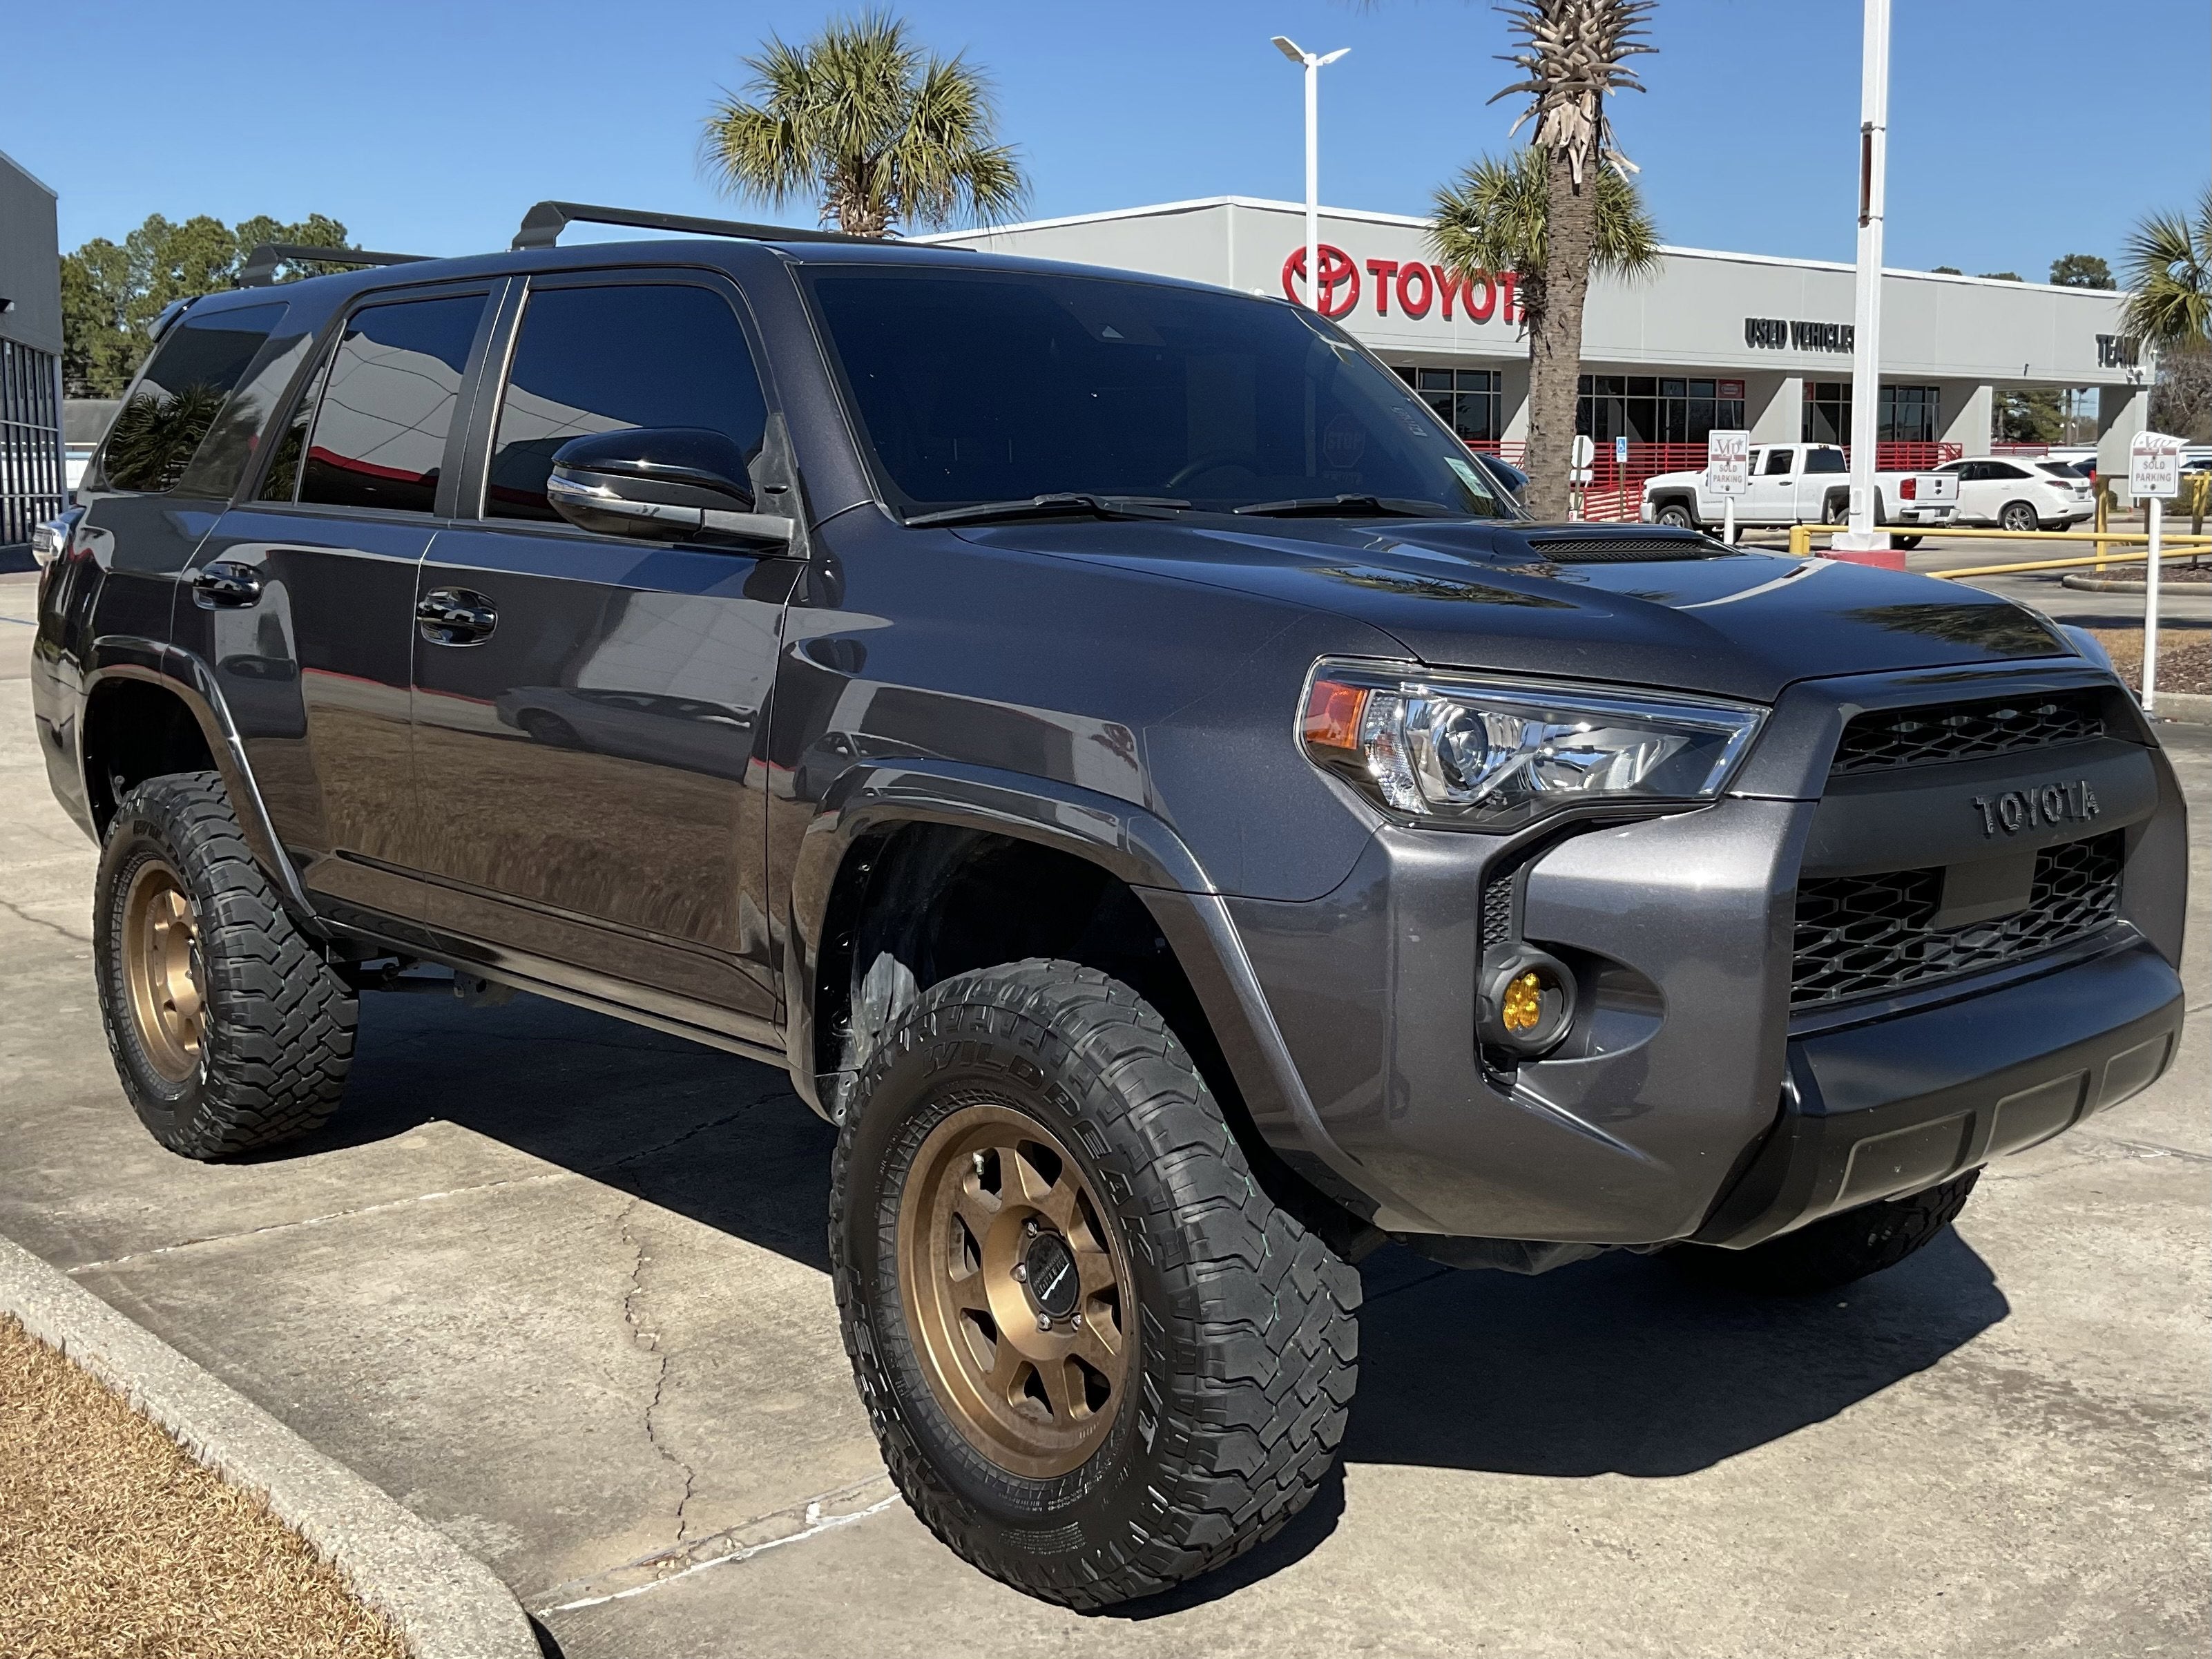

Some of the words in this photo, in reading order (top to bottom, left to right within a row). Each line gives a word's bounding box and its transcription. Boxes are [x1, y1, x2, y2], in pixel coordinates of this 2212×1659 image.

[1366, 259, 1528, 325] TOYOT
[1744, 318, 1787, 349] USED
[1719, 464, 1737, 472] SOLD
[2143, 461, 2165, 470] SOLD
[1713, 474, 1742, 483] PARKING
[2135, 472, 2172, 482] PARKING
[1973, 780, 2100, 834] TOYOTA
[923, 1039, 1155, 1265] WILDPEAK
